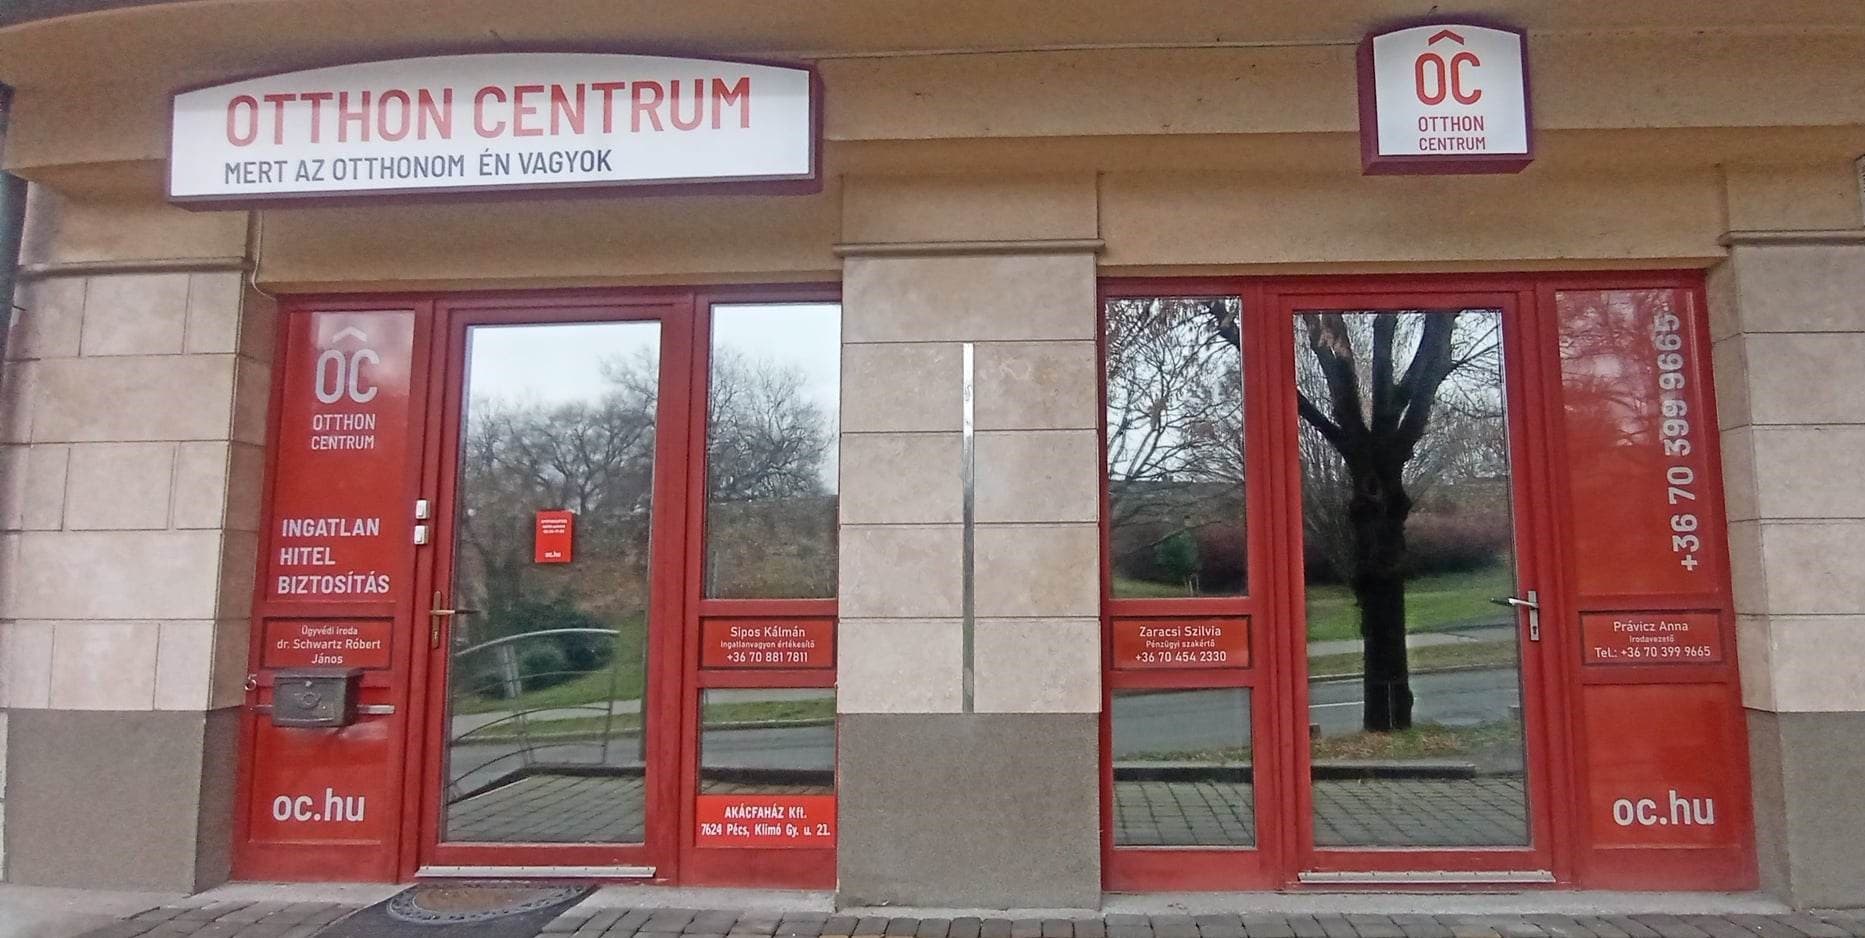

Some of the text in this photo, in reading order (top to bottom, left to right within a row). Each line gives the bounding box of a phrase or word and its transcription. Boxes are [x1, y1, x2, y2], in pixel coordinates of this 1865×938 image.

[225, 76, 751, 147] OTTHON CENTRUM
[1418, 115, 1484, 132] OTTHON
[1419, 136, 1486, 151] CENTRUM
[224, 148, 613, 185] MERT AZ OTTHONOM ÉN VAGYOK
[312, 413, 376, 431] OTTHON
[311, 435, 375, 450] CENTRUM
[1653, 314, 1699, 571] +36 70 399 9665
[282, 517, 380, 538] INGATLAN
[279, 547, 336, 566] HITEL
[277, 570, 390, 595] BIZTOSÍTÁS
[301, 625, 334, 637] Ügyvédi
[730, 625, 806, 640] Sipos Kálmán
[1139, 625, 1222, 637] Zaracsi Szilvia
[1613, 620, 1689, 632] Právicz Anna
[276, 637, 381, 650] dr. Schwartz Róbert
[720, 640, 776, 650] Ingatlanvagyon
[1145, 640, 1180, 650] Pénzügyi
[311, 653, 343, 665] János
[727, 651, 808, 663] +36 70 881 7811
[1135, 650, 1227, 663] +36 70 454 2330
[1621, 647, 1641, 657] +36
[1643, 647, 1658, 657] 70
[1661, 647, 1681, 657] 399
[1684, 646, 1711, 657] 9665
[272, 787, 365, 822] oc.hu
[724, 803, 807, 819] AKÁCFAHÁZ Kft.
[1613, 790, 1715, 826] oc.hu
[701, 823, 831, 838] 7624 Pécs, Klimó Gy. u. 21.
